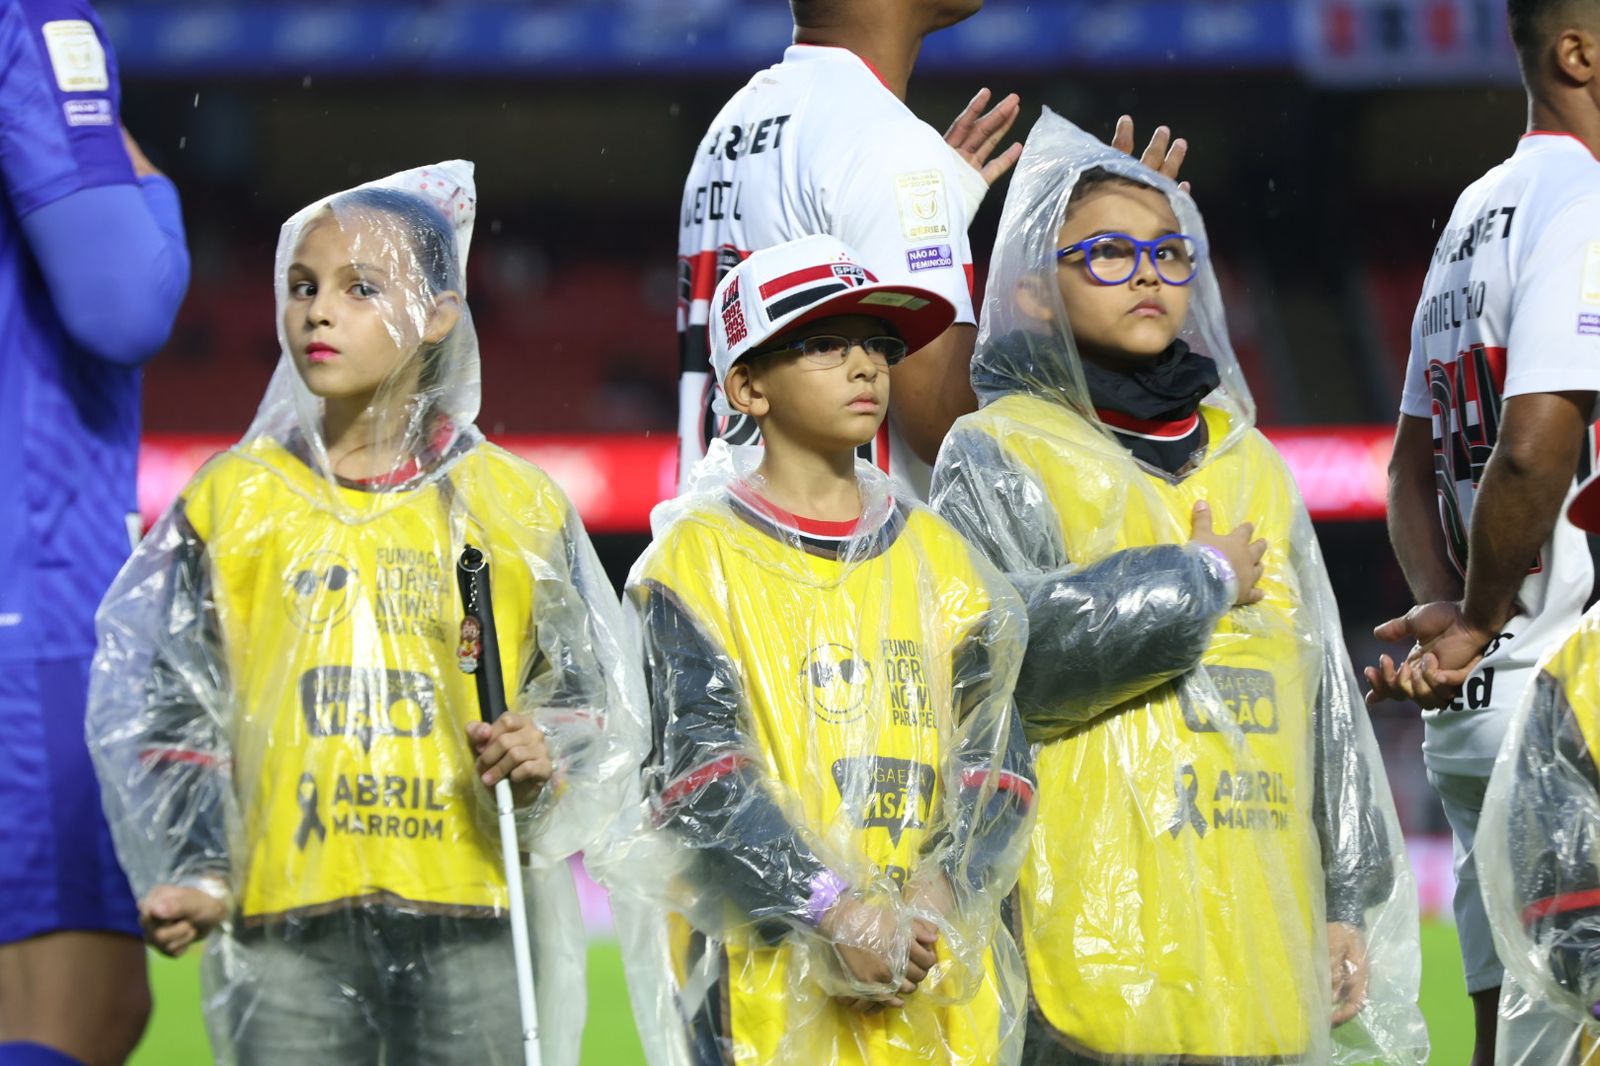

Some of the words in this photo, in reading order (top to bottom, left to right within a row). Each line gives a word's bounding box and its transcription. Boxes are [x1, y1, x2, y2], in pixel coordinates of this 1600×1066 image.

[909, 249, 928, 261] NÃO
[928, 249, 938, 258] AO
[833, 265, 864, 277] SPFC
[721, 300, 742, 325] 1992
[724, 313, 745, 338] 1993
[726, 326, 748, 351] 2005
[333, 773, 446, 811] ABRIL
[333, 814, 443, 840] MARROM
